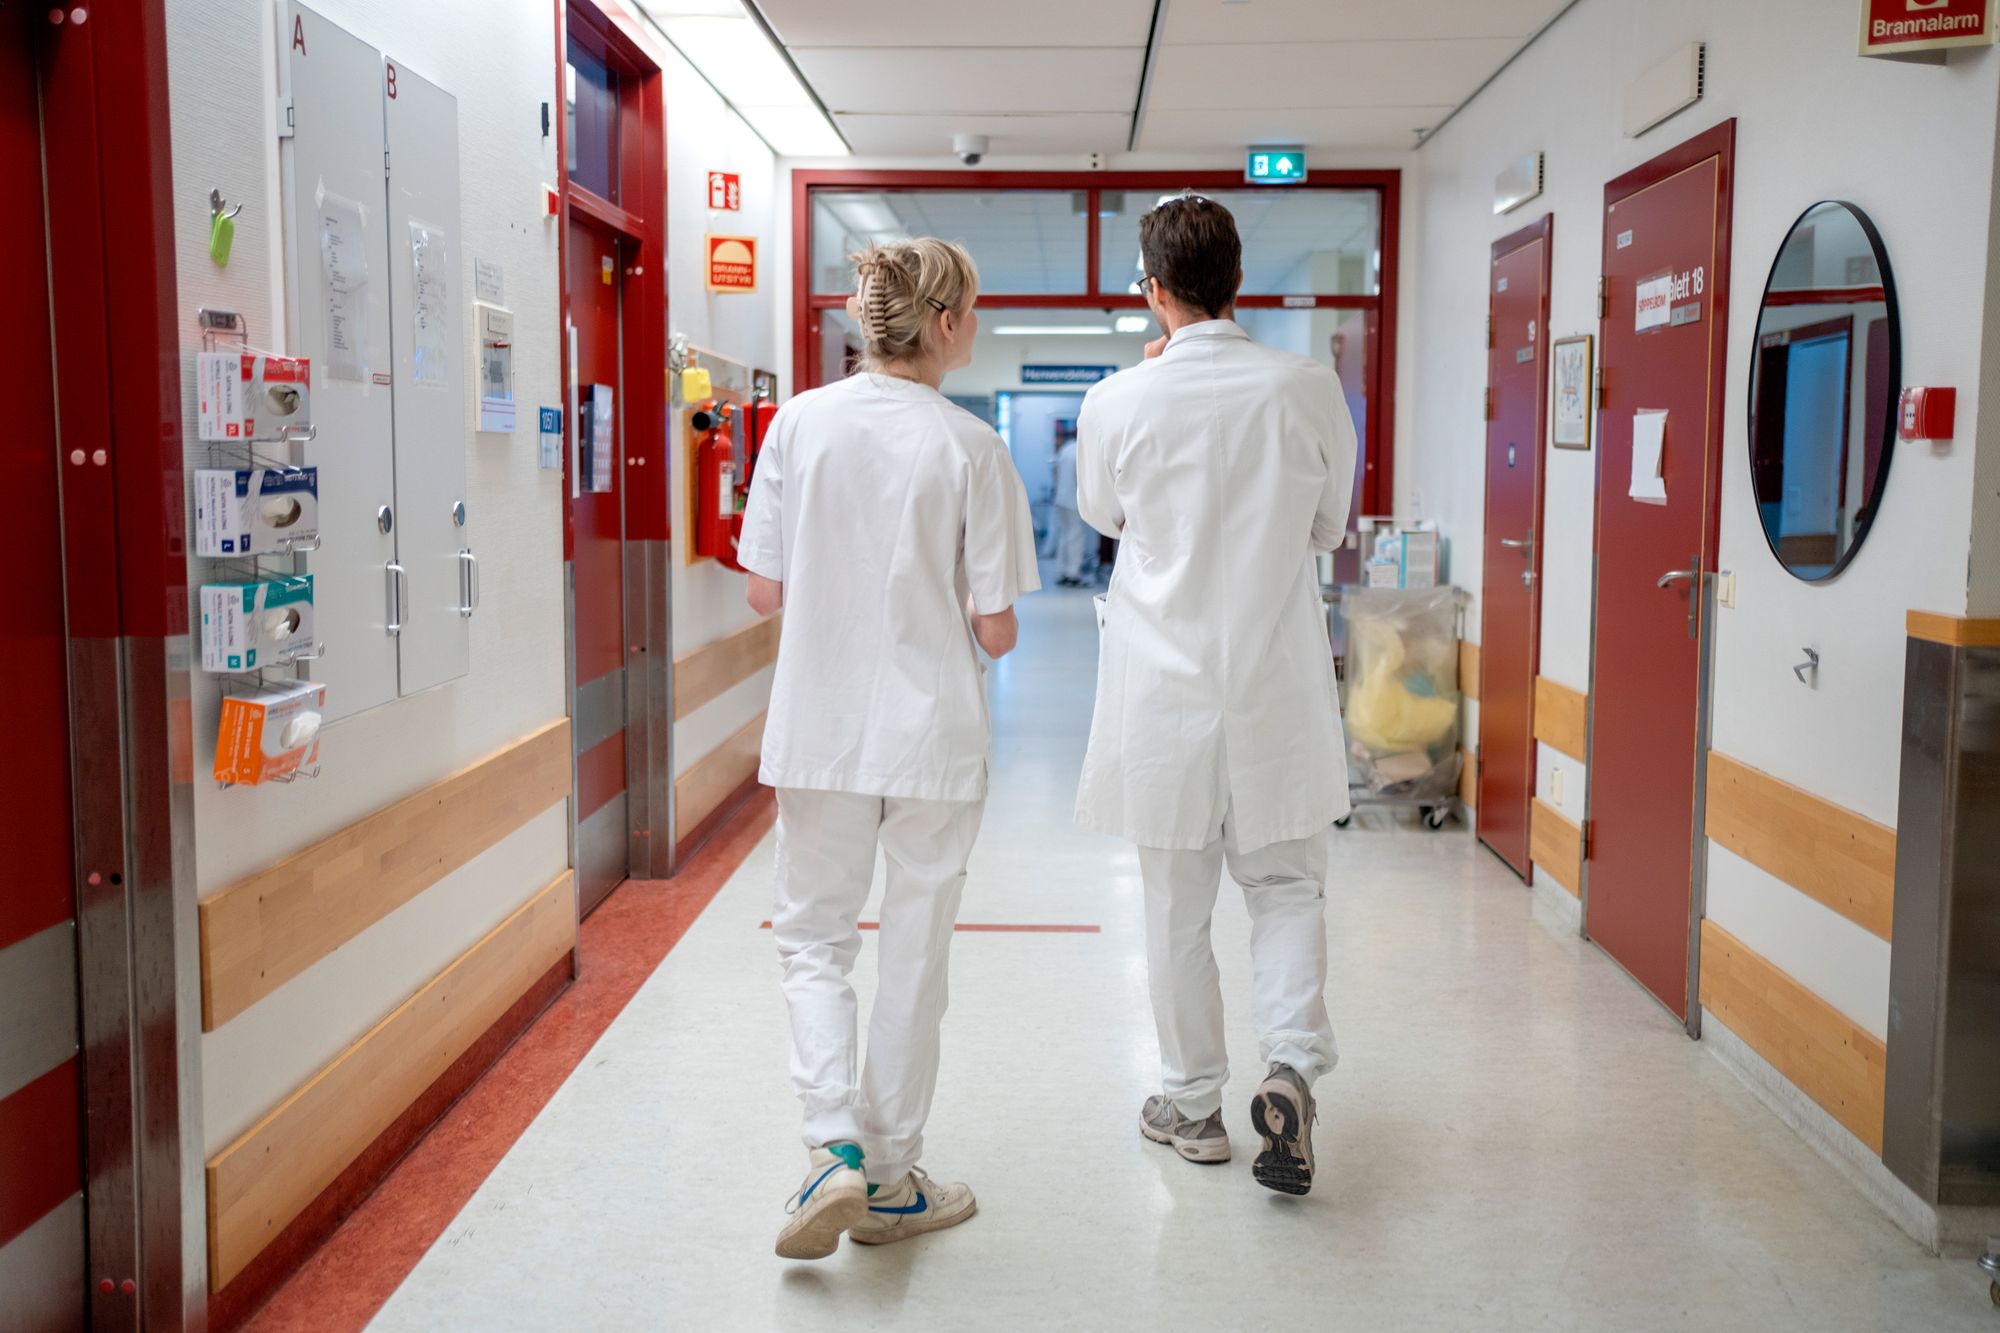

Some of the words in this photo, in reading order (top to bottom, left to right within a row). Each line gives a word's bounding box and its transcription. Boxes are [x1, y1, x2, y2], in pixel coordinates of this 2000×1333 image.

[293, 14, 306, 56] A
[1872, 13, 1979, 37] Brannalarm
[387, 63, 397, 100] B
[713, 274, 751, 284] UTSTYR
[1692, 266, 1704, 295] 18
[229, 424, 236, 436] XL
